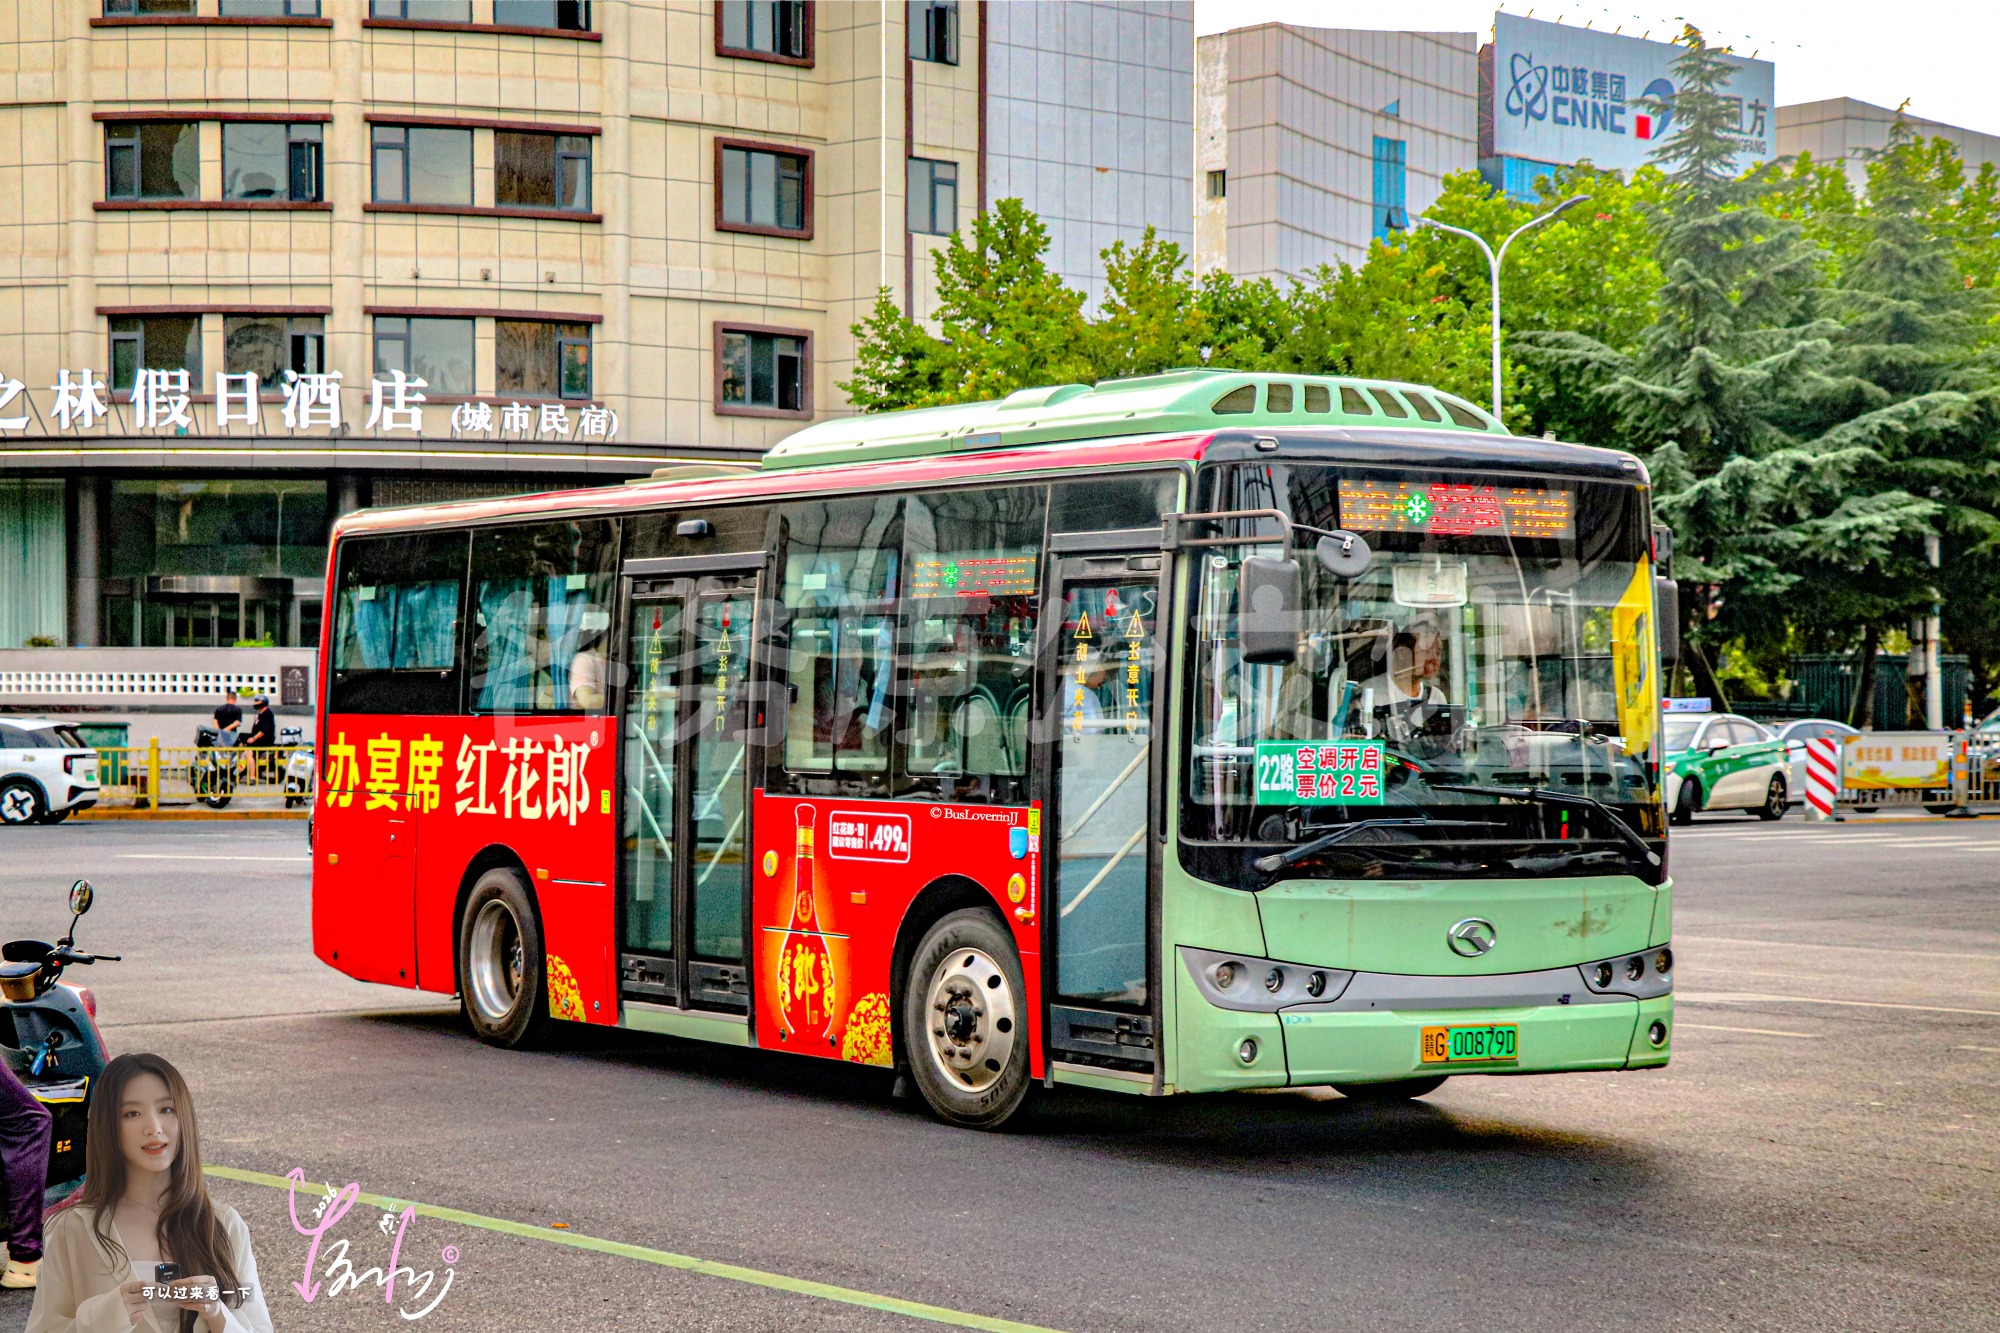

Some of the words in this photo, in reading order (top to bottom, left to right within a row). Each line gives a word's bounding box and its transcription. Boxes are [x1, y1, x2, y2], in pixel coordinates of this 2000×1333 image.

[1552, 63, 1627, 104] 中核集团
[1552, 96, 1627, 134] CNNC
[0, 367, 429, 431] 之林假日酒店
[451, 401, 619, 437] (城市民宿)
[325, 731, 444, 814] 办宴席
[1258, 753, 1294, 792] 22路
[1296, 745, 1380, 771] 空调开启
[1296, 773, 1380, 799] 票价2元
